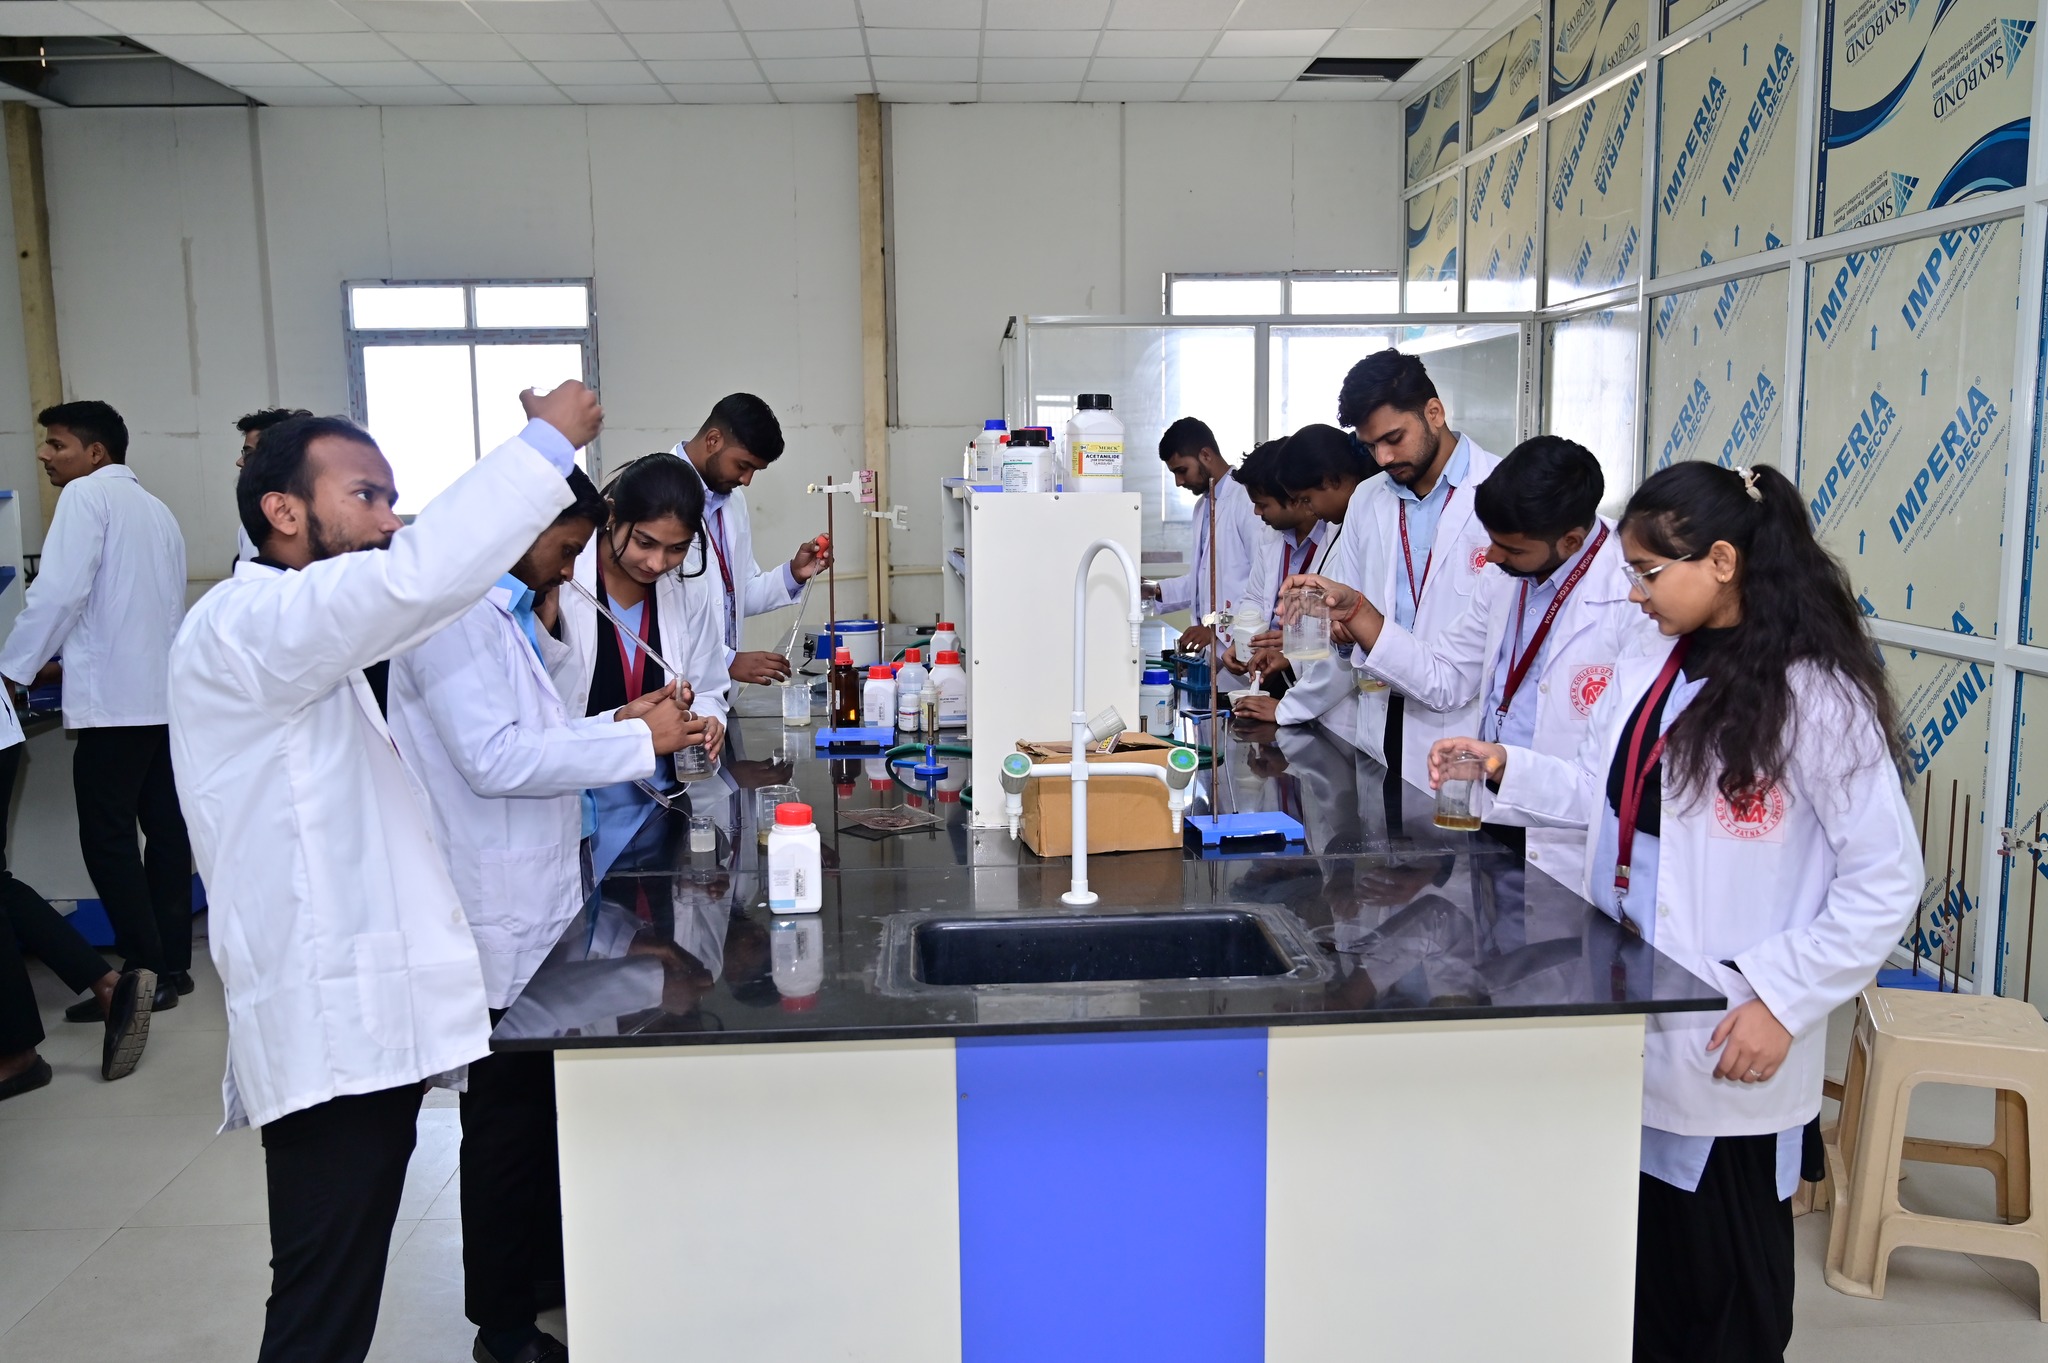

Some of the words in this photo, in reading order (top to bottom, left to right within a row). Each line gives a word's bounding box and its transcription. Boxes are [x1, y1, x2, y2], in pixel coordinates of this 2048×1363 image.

[1566, 0, 1594, 32] SKYBON
[1608, 22, 1640, 70] SKYBOND
[1847, 0, 1906, 63] SKYBOND
[1970, 26, 1997, 54] Aluminium
[1766, 52, 1794, 118] DECOR
[1931, 61, 1948, 78] Company
[1932, 74, 1946, 89] Panel
[1933, 78, 1954, 100] BUILDINGS
[1934, 46, 2004, 118] SKYBOND
[1947, 52, 1968, 74] Partition
[1955, 64, 1971, 81] BETTER
[1598, 73, 1643, 195] IMPERIA
[1663, 76, 1721, 215] IMPERIA
[1702, 85, 1727, 145] DECOR
[1722, 43, 1789, 196] IMPERIA
[1504, 134, 1531, 209] PERIA
[1555, 98, 1596, 211] IMPERIA
[1594, 136, 1611, 186] DECOR
[1472, 153, 1497, 223] PERIA
[1854, 196, 1893, 228] SKYB
[1815, 252, 1865, 342] IMPE
[1901, 228, 1965, 332] IMPE
[1937, 298, 1950, 321] PLASTIC
[1950, 269, 1967, 299] ALUMINIUM
[1966, 237, 1984, 269] COMPOSITE
[1655, 378, 1706, 472] PERIA
[1687, 391, 1711, 442] DECOR
[1718, 372, 1771, 468] PERIA
[1749, 386, 1776, 441] DECOR
[1860, 407, 1896, 470] DECOR
[1955, 403, 1998, 474] DECOR
[1889, 386, 1990, 544] IMPERIA
[1974, 450, 1990, 476] CERTIFIED
[1990, 425, 2006, 450] COMPANY
[1922, 520, 1936, 540] PLASTIC
[1936, 494, 1953, 521] ALUMINIUM
[1952, 466, 1971, 494] COMPOSITE
[1970, 451, 1982, 467] PANEL
[1579, 552, 1593, 570] MGM
[1544, 602, 1559, 624] PATNA
[1574, 668, 1598, 685] COLLEGE
[1904, 662, 1986, 786] IMPERI
